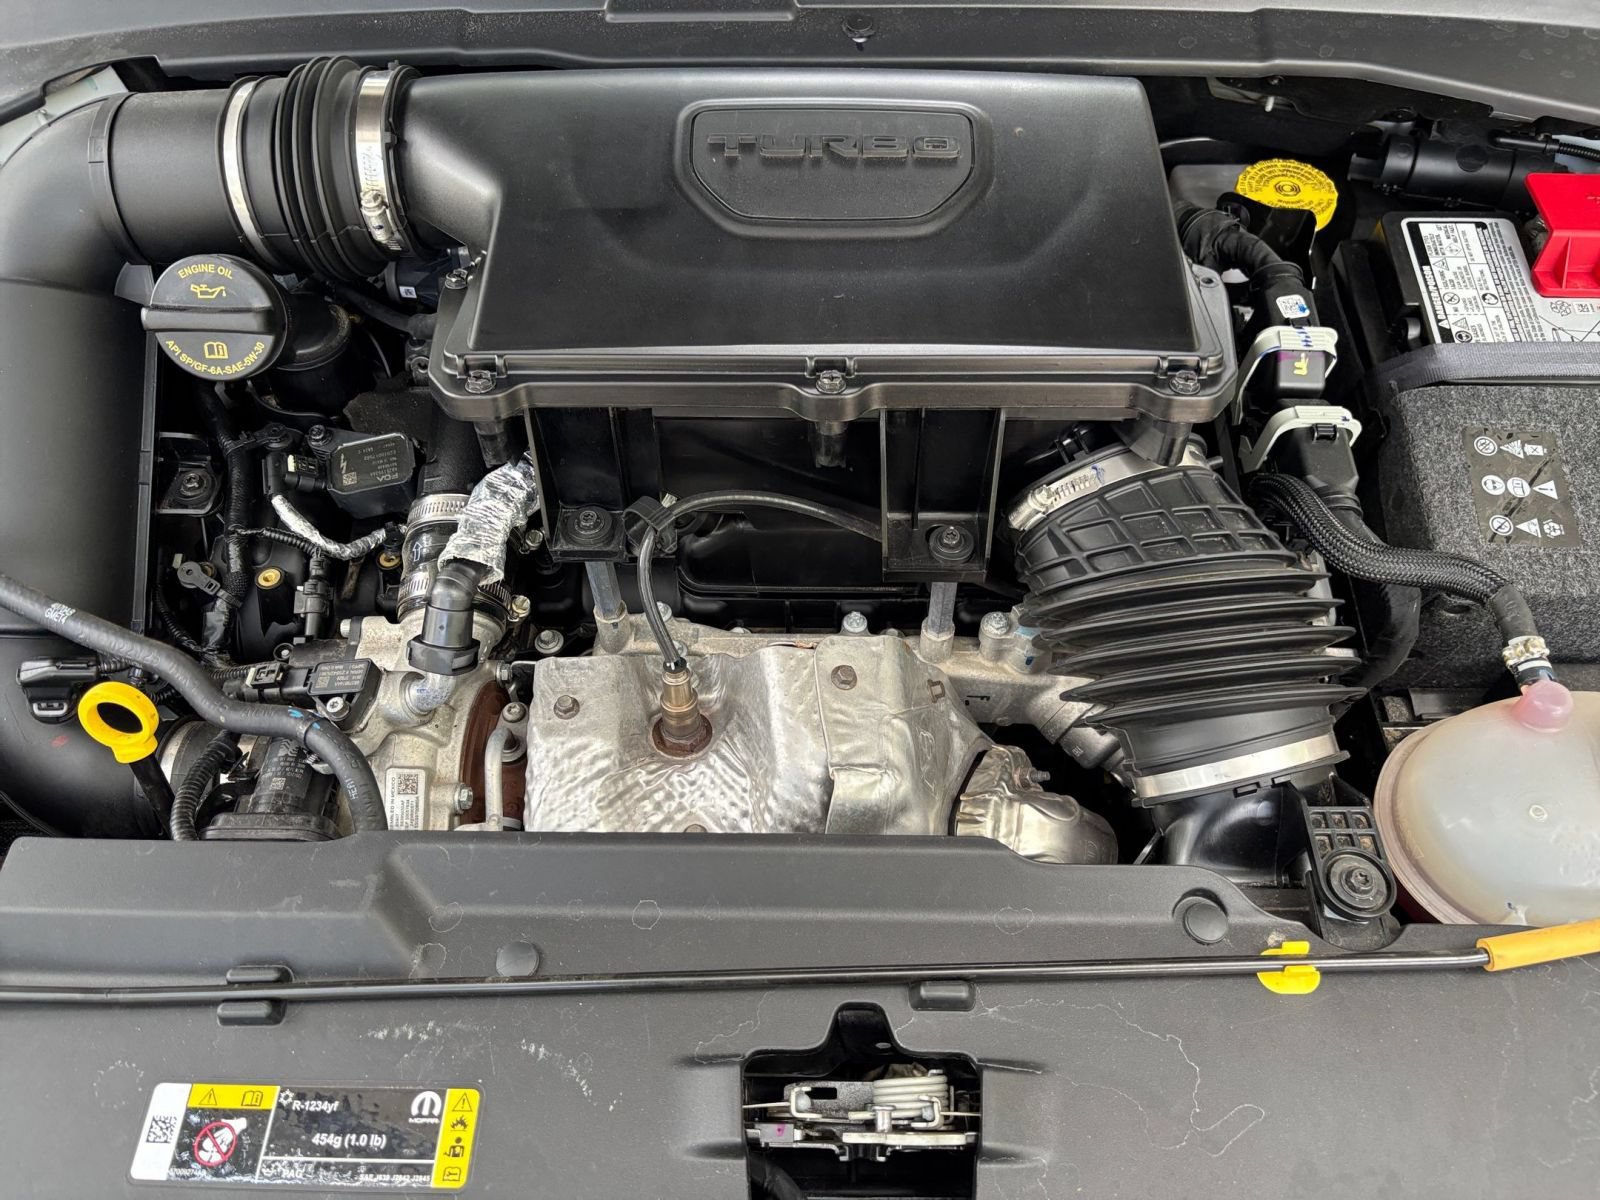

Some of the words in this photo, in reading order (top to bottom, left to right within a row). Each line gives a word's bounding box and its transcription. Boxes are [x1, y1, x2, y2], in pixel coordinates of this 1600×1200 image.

[707, 133, 960, 159] TURBO
[177, 263, 215, 279] ENGINE
[217, 265, 234, 280] OIL
[1421, 265, 1447, 319] DANGER/POISON
[166, 339, 181, 356] API
[292, 1100, 340, 1114] R-1234yf
[311, 1133, 342, 1149] 454g
[344, 1133, 368, 1149] (1.0
[369, 1133, 387, 1150] lb)
